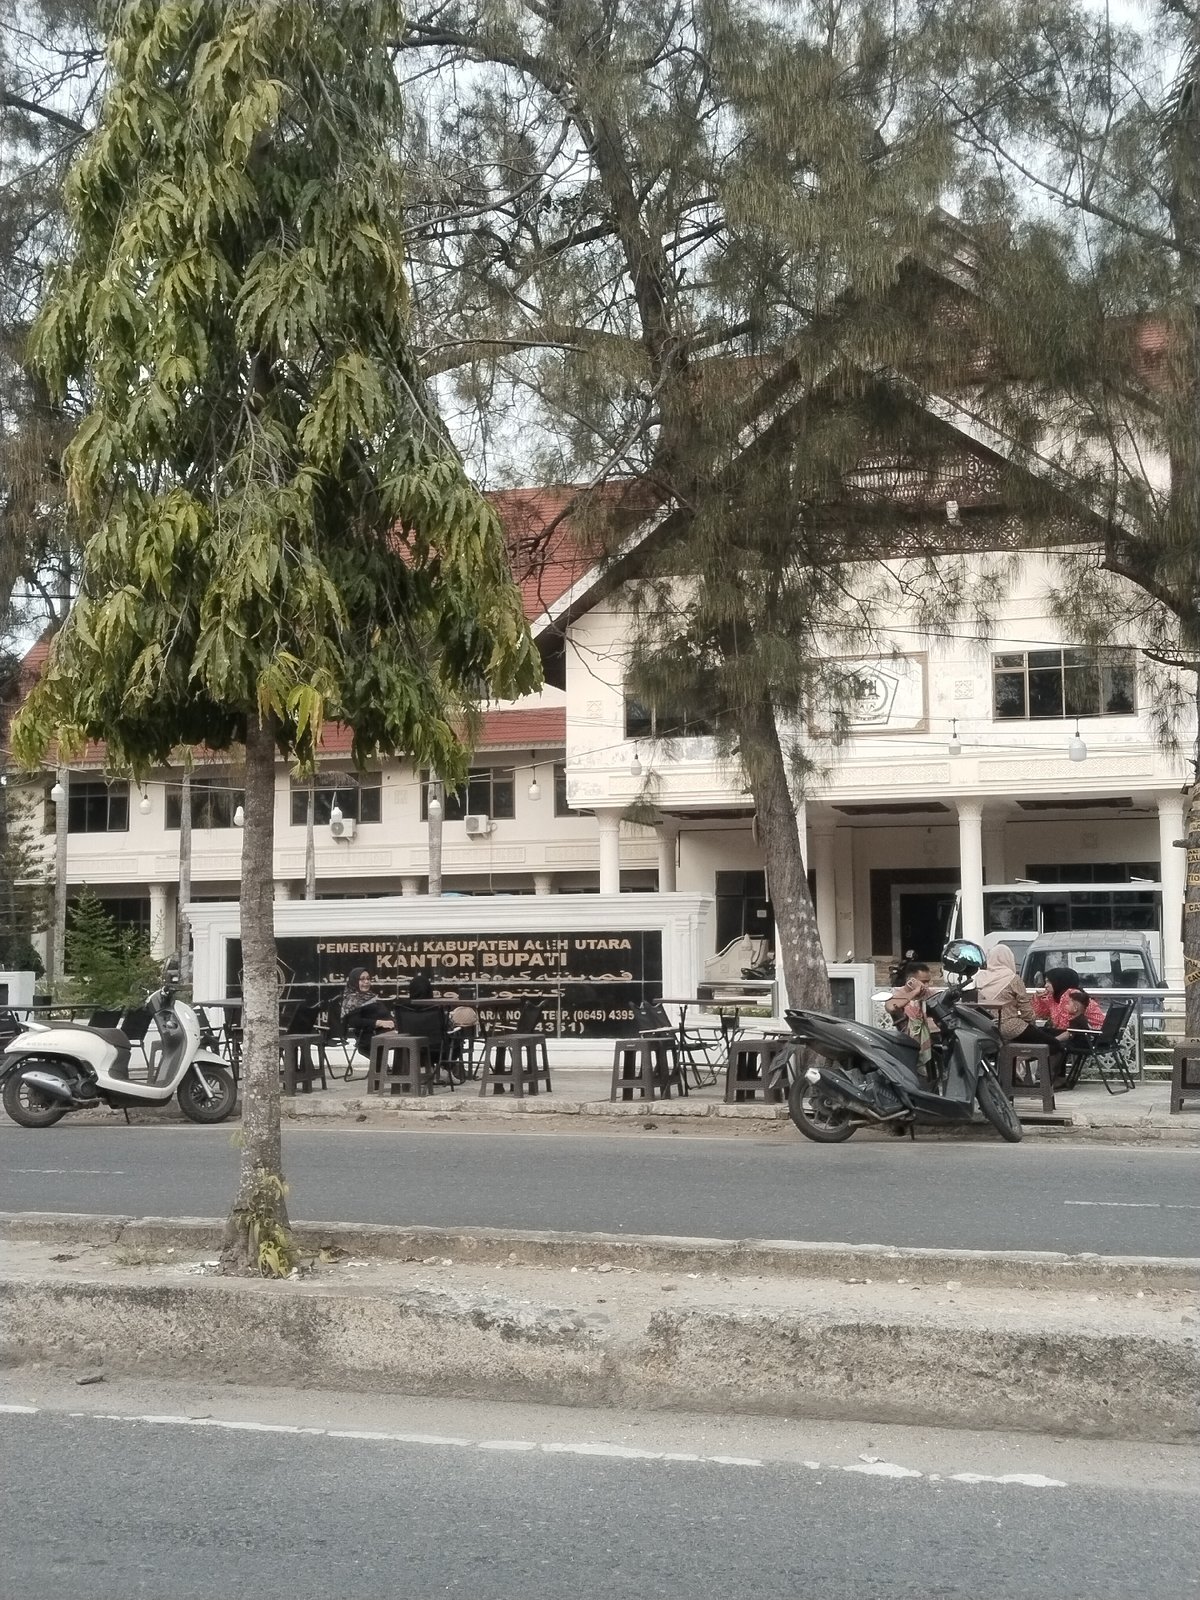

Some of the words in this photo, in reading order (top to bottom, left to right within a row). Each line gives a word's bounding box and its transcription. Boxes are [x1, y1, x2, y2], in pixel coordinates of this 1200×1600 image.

[317, 941, 418, 954] PEMERINTAH
[423, 940, 518, 953] KABUPATEN
[523, 939, 568, 951] ACEH
[575, 938, 632, 950] UTARA
[376, 953, 475, 968] KANTOR
[482, 952, 567, 967] BUPATI
[542, 1010, 571, 1020] TEP.
[573, 1010, 606, 1022] (0645)
